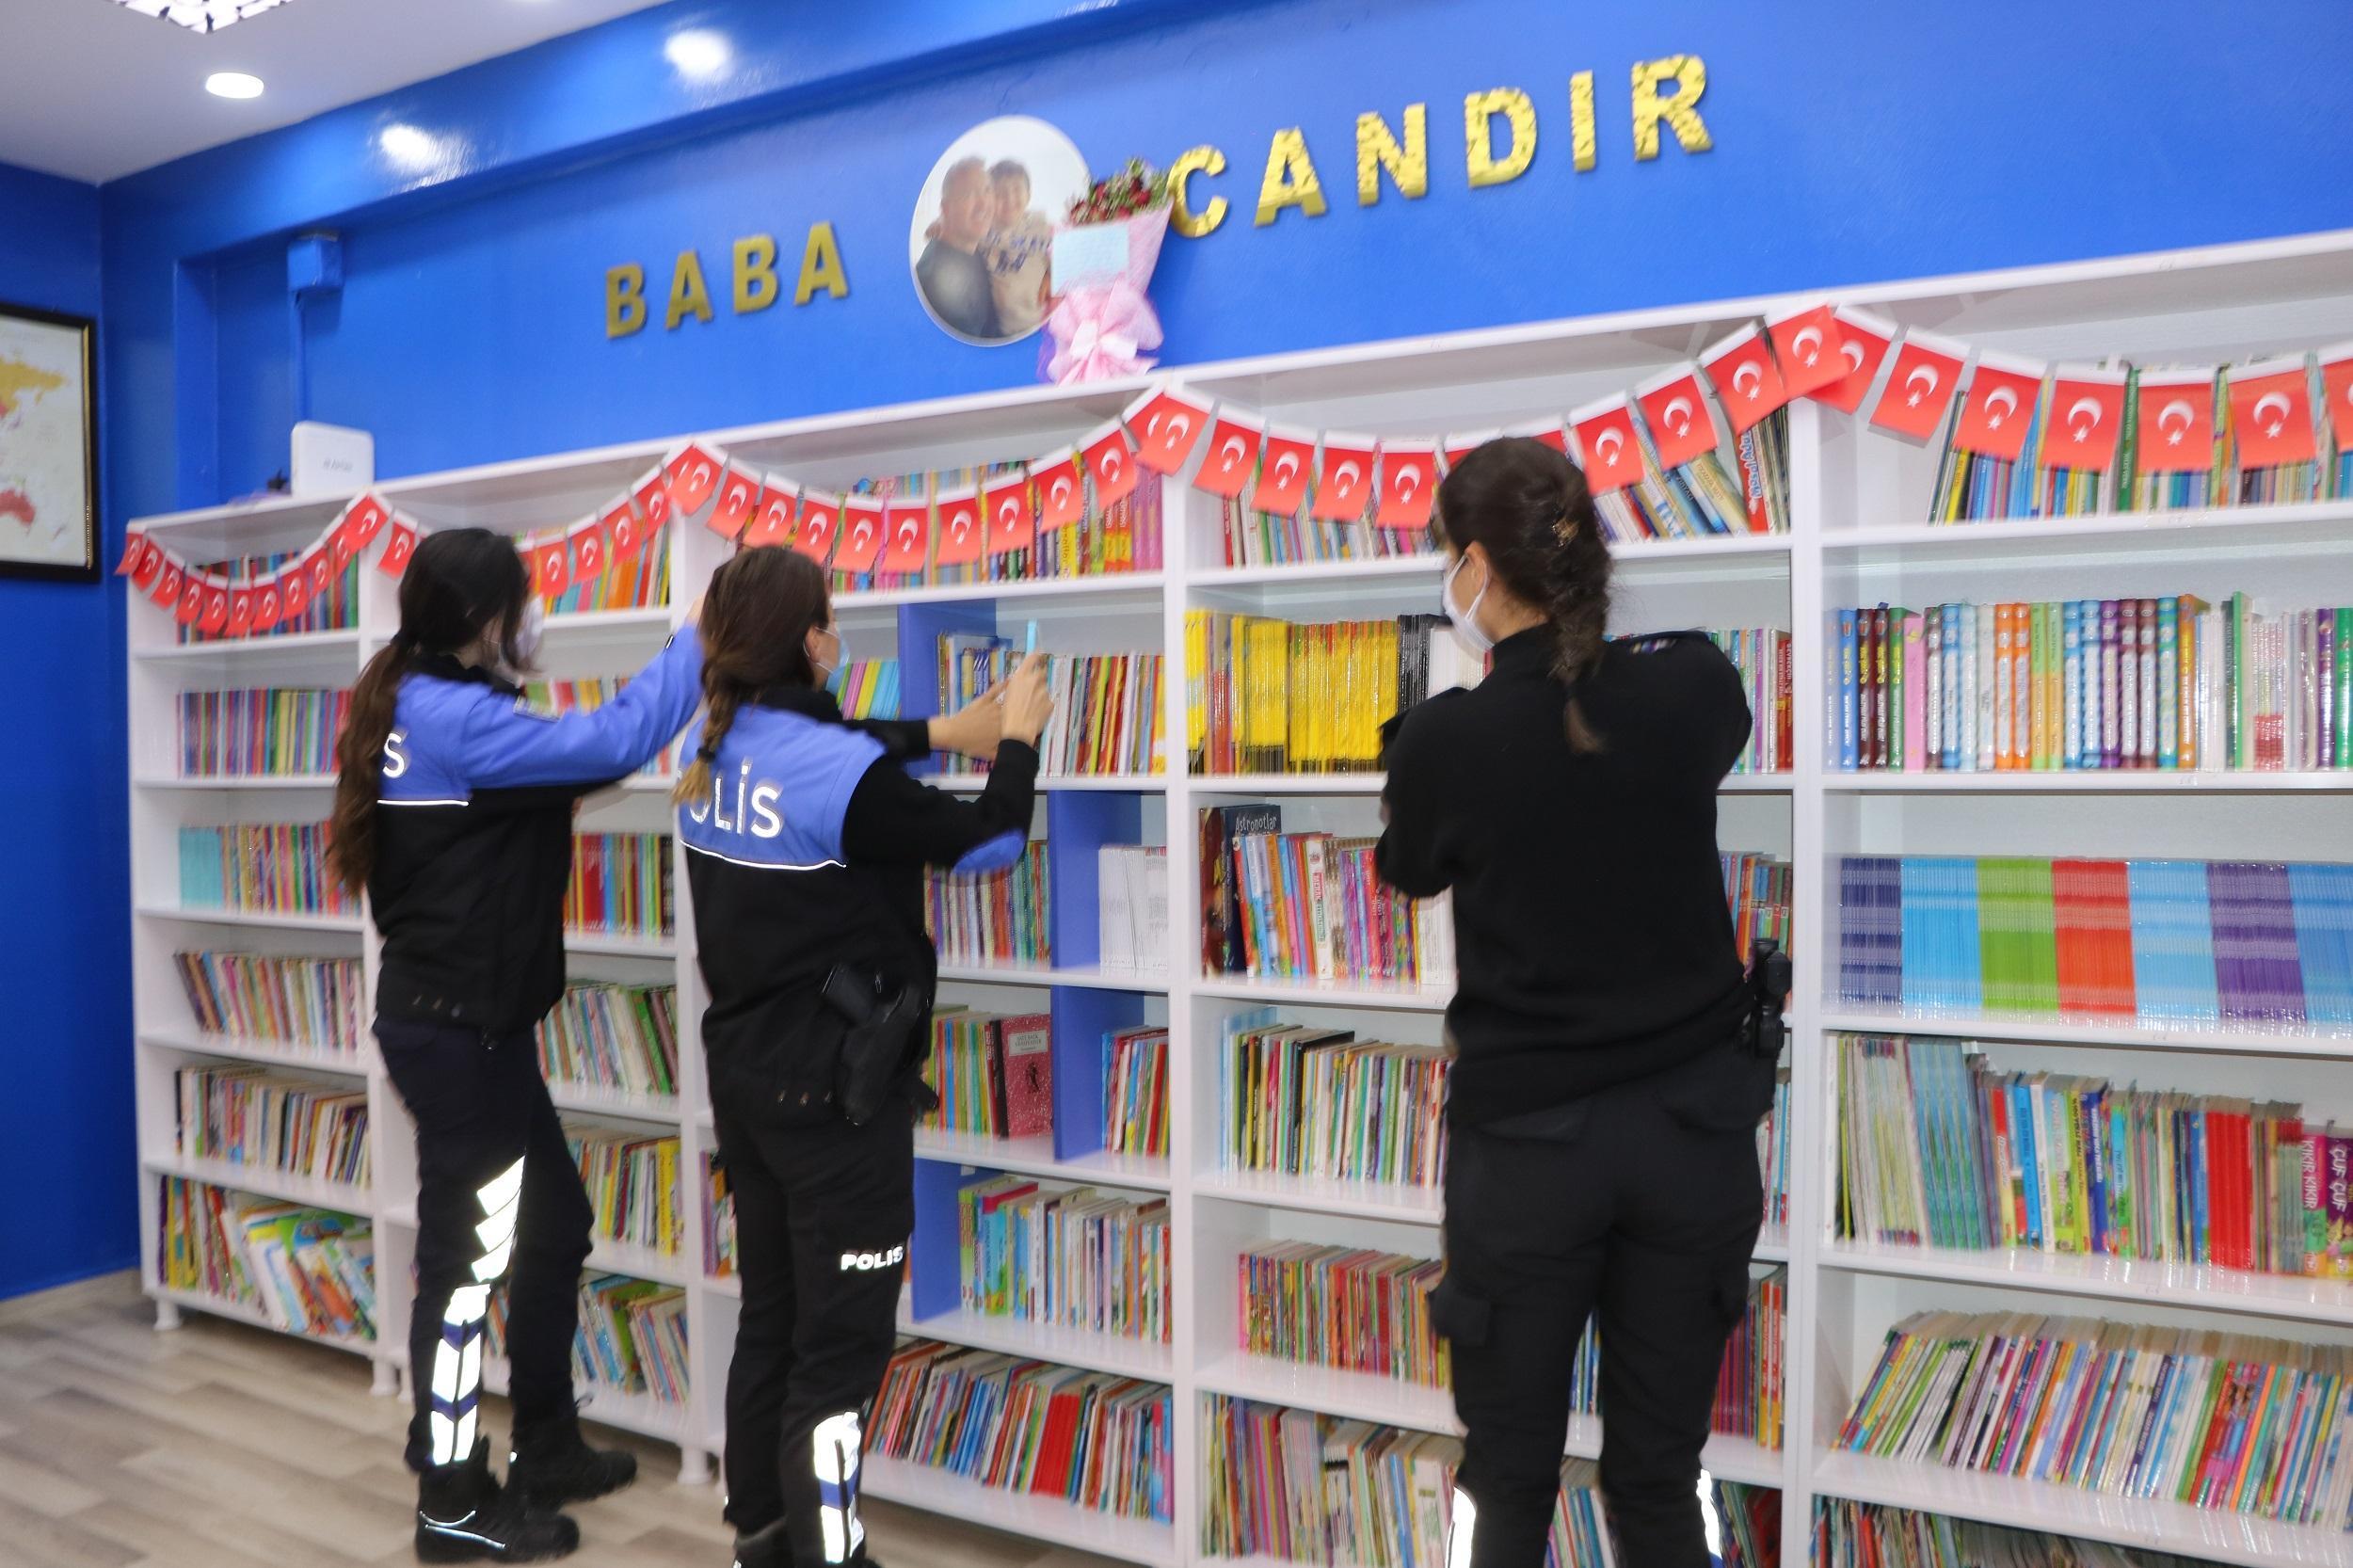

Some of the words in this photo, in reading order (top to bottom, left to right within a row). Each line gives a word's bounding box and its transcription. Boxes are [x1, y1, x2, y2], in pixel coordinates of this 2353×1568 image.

[606, 220, 849, 340] BABA
[1167, 54, 1713, 238] CANDIR
[1235, 812, 1277, 832] Astronotlar
